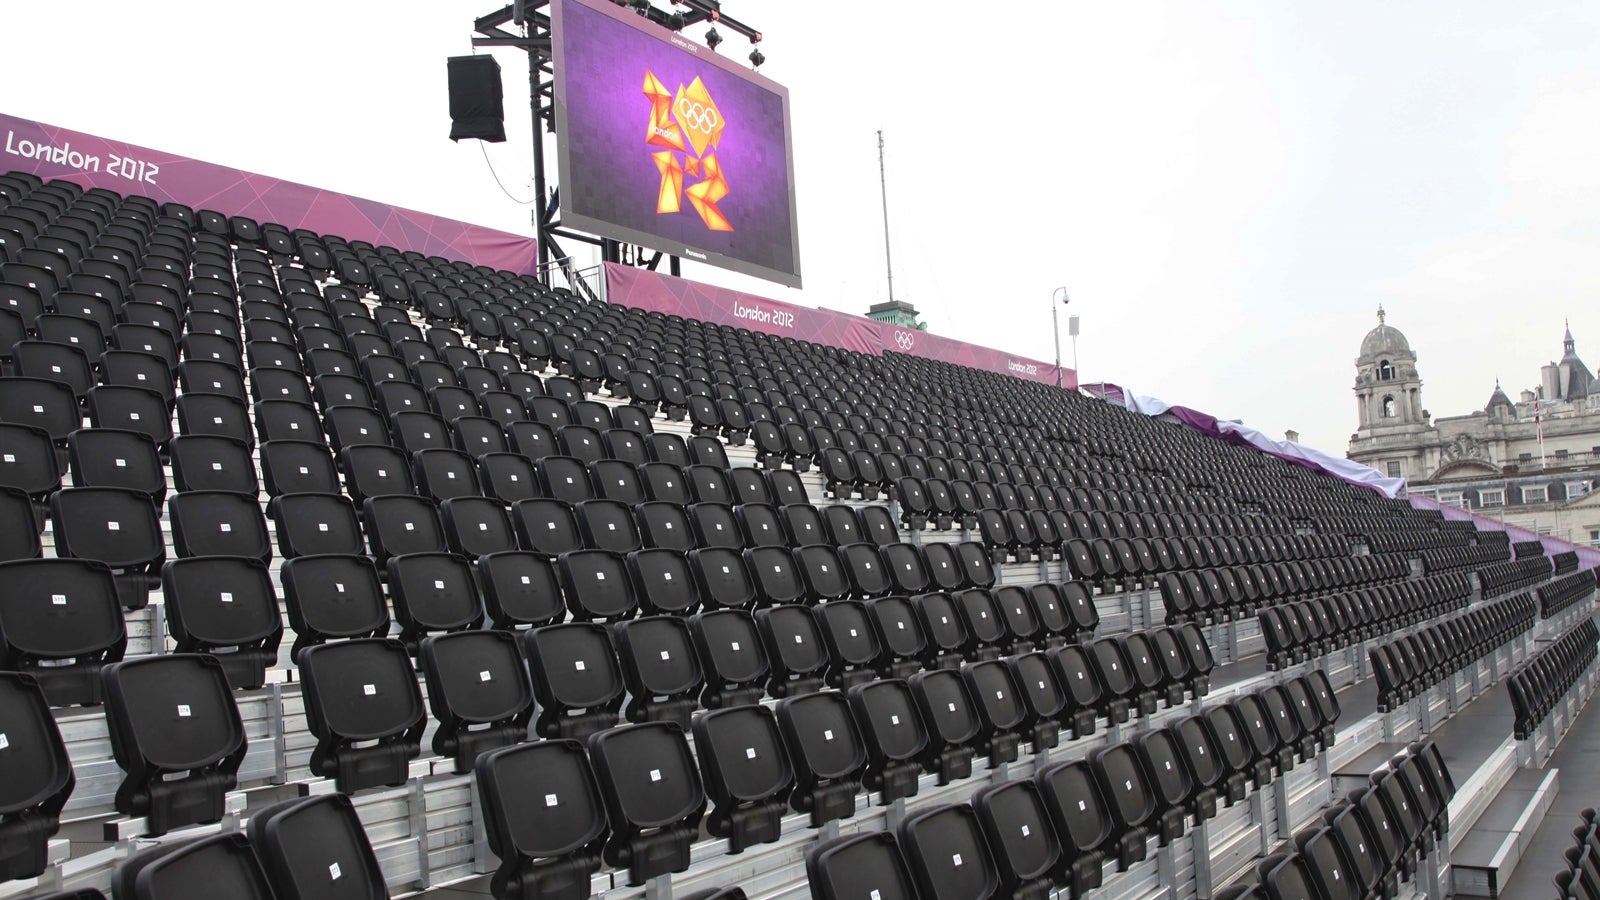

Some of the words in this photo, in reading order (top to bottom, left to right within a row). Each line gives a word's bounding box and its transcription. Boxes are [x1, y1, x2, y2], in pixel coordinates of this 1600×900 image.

[5, 130, 100, 172] London
[106, 153, 160, 185] 2012
[733, 300, 771, 324] London
[772, 309, 795, 329] 2012
[1008, 359, 1026, 374] London
[1026, 363, 1037, 377] 2012
